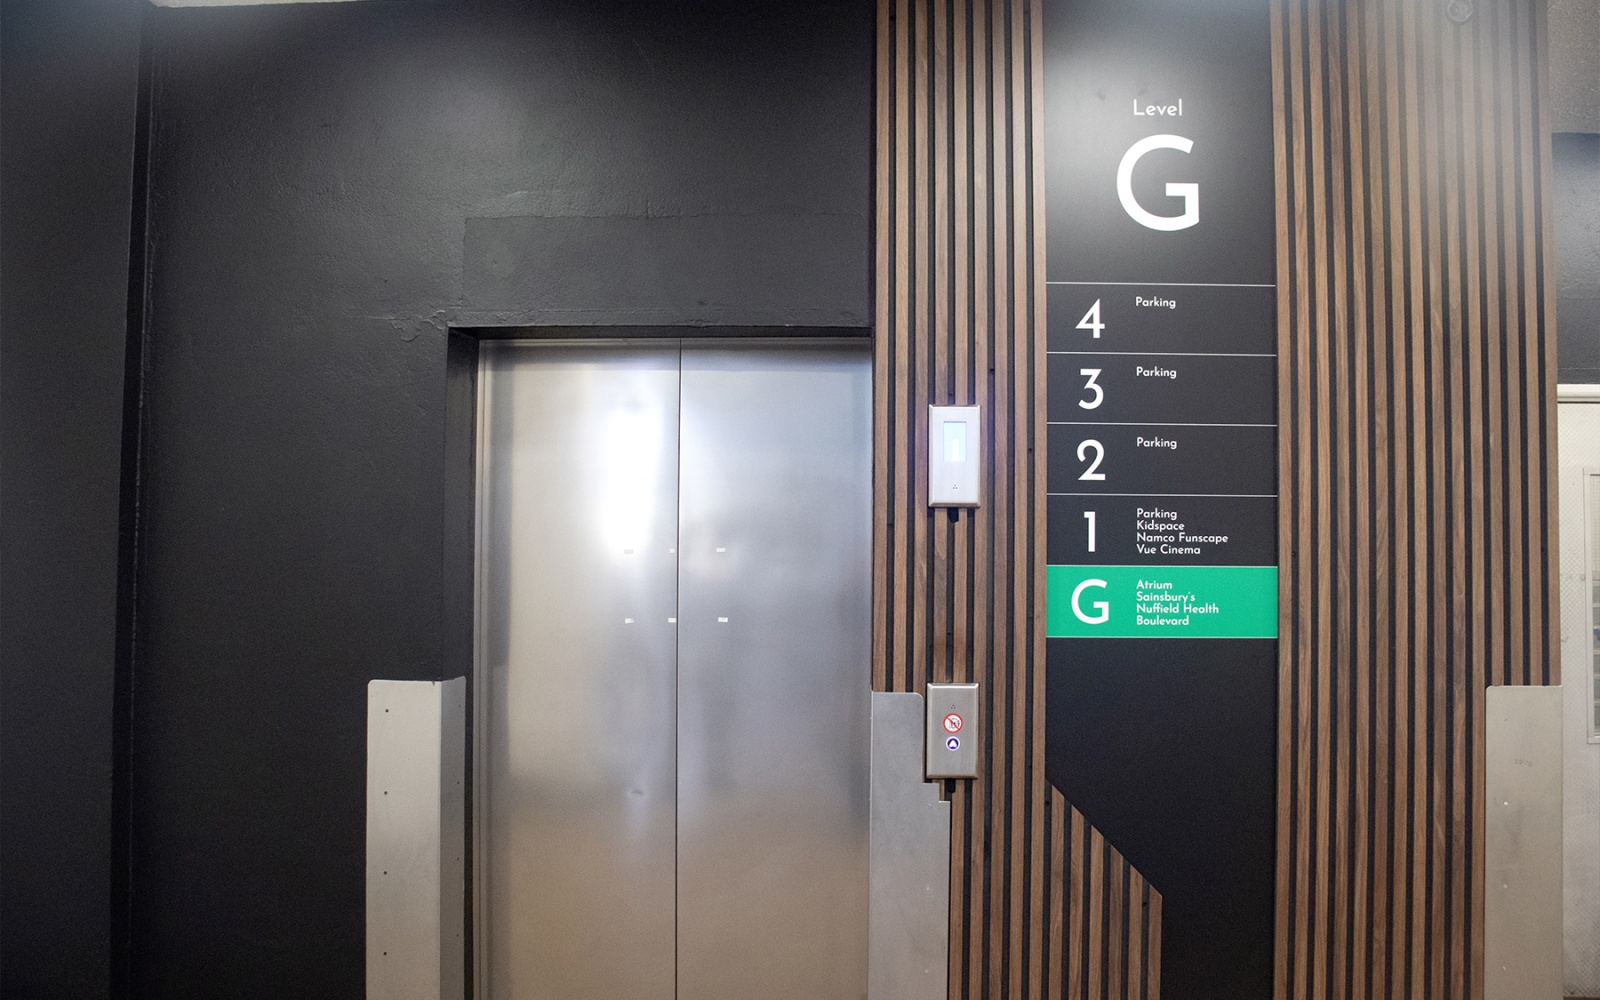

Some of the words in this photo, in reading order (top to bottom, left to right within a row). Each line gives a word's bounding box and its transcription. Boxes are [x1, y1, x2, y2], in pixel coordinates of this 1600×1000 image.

[1133, 98, 1183, 117] Level
[1116, 133, 1200, 232] G
[1135, 296, 1177, 310] Parking
[1075, 298, 1106, 339] 4
[1136, 366, 1178, 380] Parking
[1078, 368, 1104, 410] 3
[1136, 436, 1178, 450] Parking
[1076, 439, 1106, 481] 2
[1136, 507, 1178, 521] Parking
[1083, 511, 1096, 552] 1
[1136, 519, 1185, 532] Kidspace
[1136, 532, 1175, 543] Namco
[1178, 532, 1229, 545] Funscape
[1136, 543, 1157, 555] Vue
[1159, 543, 1201, 555] Cinema
[1136, 579, 1173, 590] Atrium
[1070, 577, 1110, 625] G
[1136, 590, 1196, 604] Sainsbury's
[1136, 602, 1180, 614] Nuffield
[1183, 602, 1220, 614] Health
[1136, 614, 1190, 626] Boulevard
